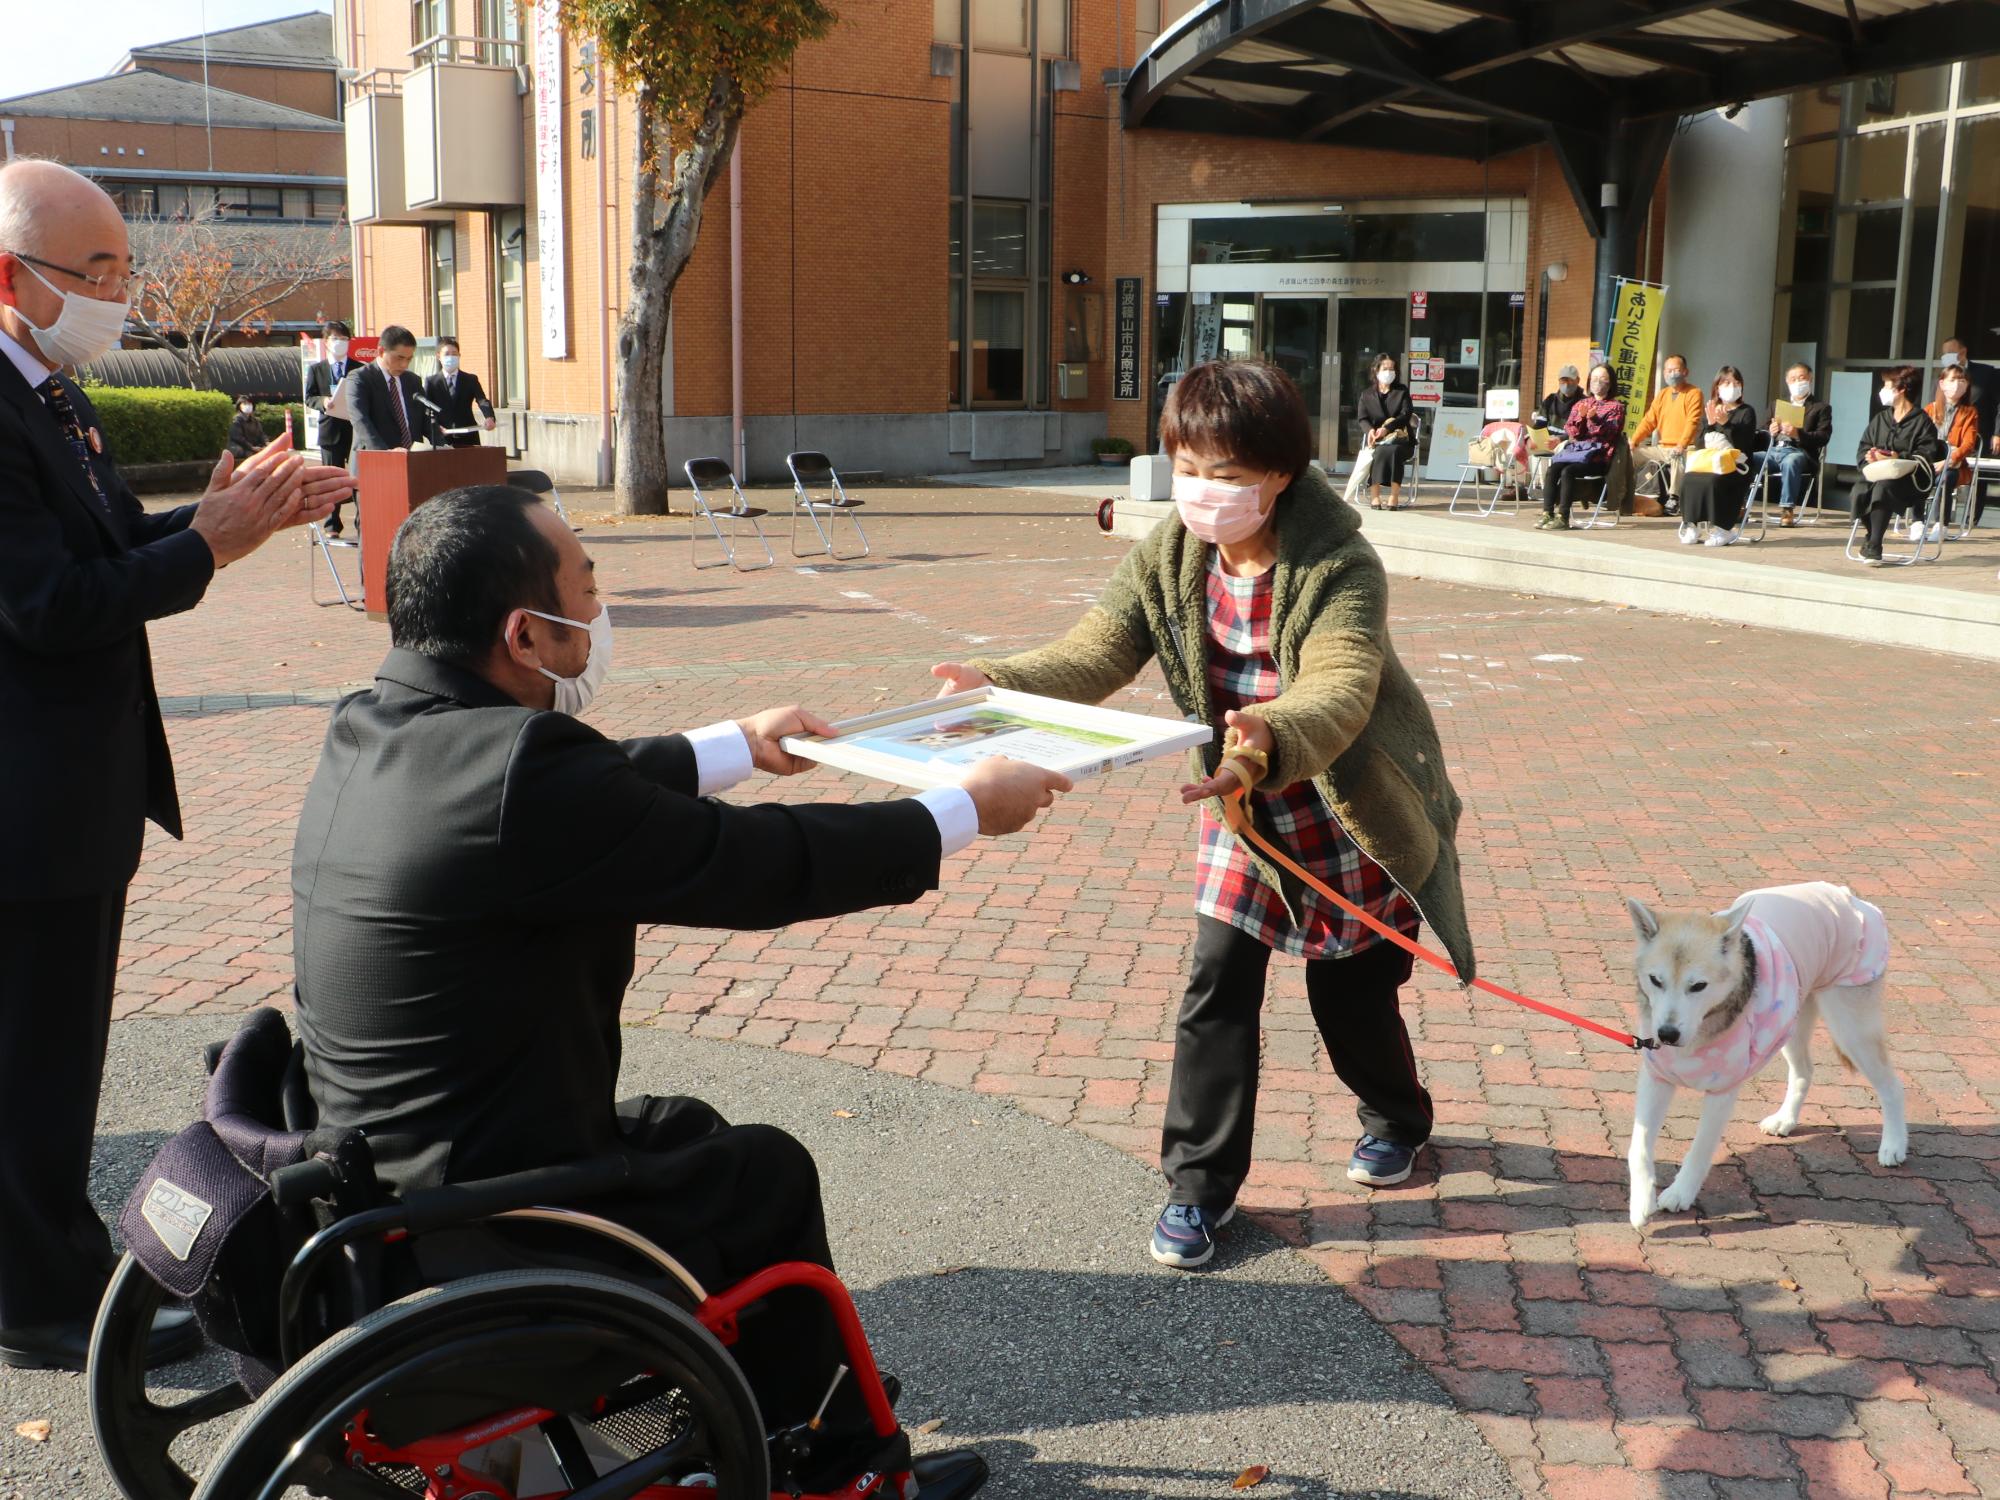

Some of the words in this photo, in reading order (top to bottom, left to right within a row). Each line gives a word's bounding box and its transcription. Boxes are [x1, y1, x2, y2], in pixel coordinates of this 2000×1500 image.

[1119, 280, 1134, 397] 丹波篠山市丹南支所
